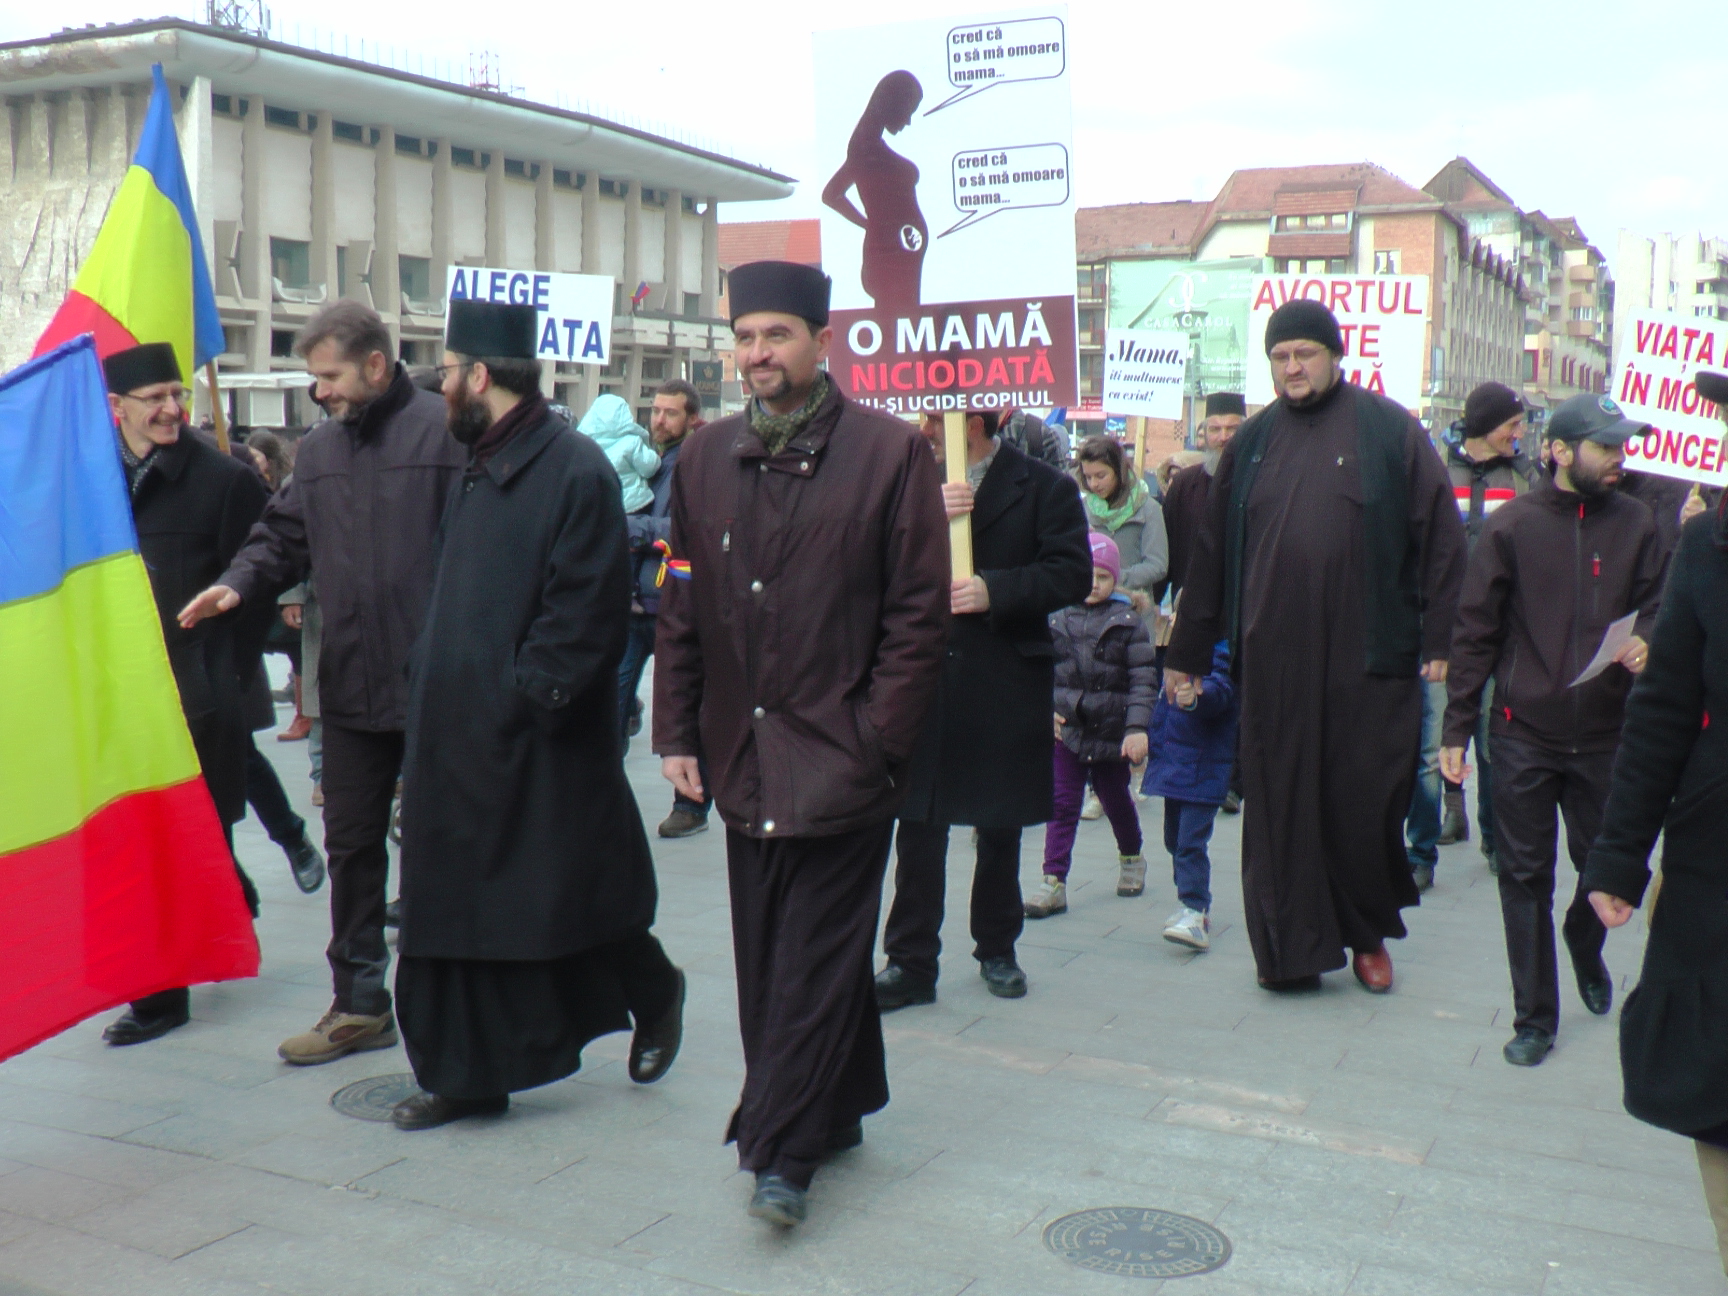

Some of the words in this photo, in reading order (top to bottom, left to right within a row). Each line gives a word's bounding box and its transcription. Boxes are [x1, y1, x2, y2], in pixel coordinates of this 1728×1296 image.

[952, 29, 983, 44] cred
[986, 26, 1003, 41] că
[953, 51, 961, 63] o
[964, 47, 980, 62] să
[983, 45, 1004, 60] mă
[1007, 41, 1060, 57] omoare
[954, 67, 1005, 82] mama...
[958, 154, 988, 169] cred
[991, 151, 1008, 166] că
[959, 176, 967, 188] o
[970, 172, 986, 187] să
[988, 170, 1010, 185] mă
[1012, 167, 1065, 182] omoare
[960, 191, 1010, 207] mama...
[449, 268, 551, 312] ALEGE
[1253, 279, 1423, 315] AVORTUL
[848, 319, 883, 356] O
[896, 301, 1053, 354] MAMĂ
[1339, 323, 1381, 358] TE
[1637, 319, 1714, 374] VIAȚA
[1109, 339, 1184, 368] Mama,
[851, 348, 1056, 392] NICIODATĂ
[1123, 371, 1183, 385] multumesc
[908, 393, 967, 412] UCIDE
[972, 390, 1054, 409] COPILUL
[1122, 389, 1154, 402] exist!
[1620, 362, 1653, 406] ÎN
[1657, 377, 1720, 420] MOM
